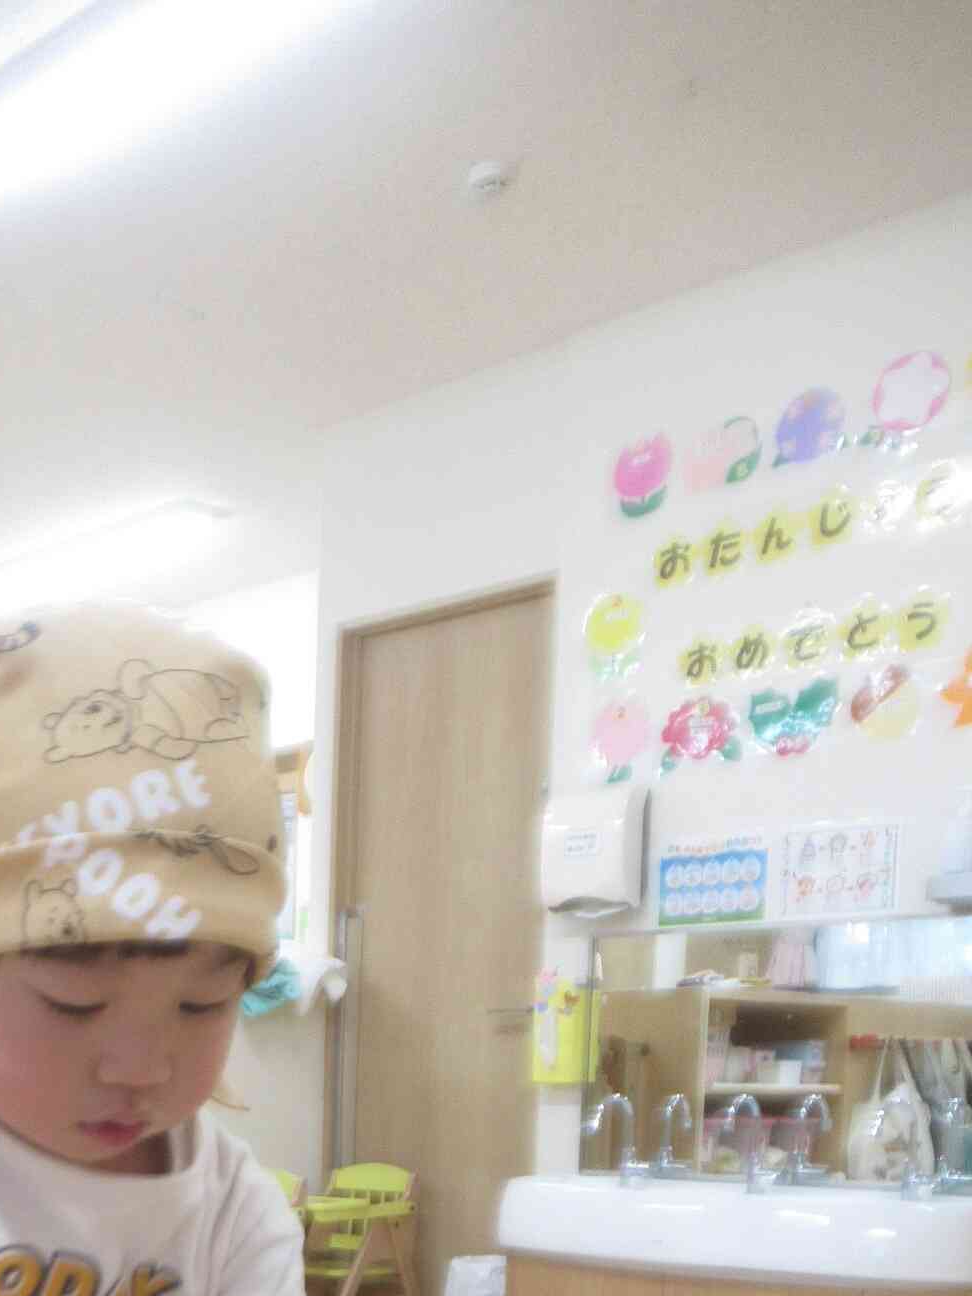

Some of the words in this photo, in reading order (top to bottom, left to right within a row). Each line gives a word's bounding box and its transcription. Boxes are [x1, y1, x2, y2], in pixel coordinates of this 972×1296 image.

[685, 602, 936, 681] おめでとう
